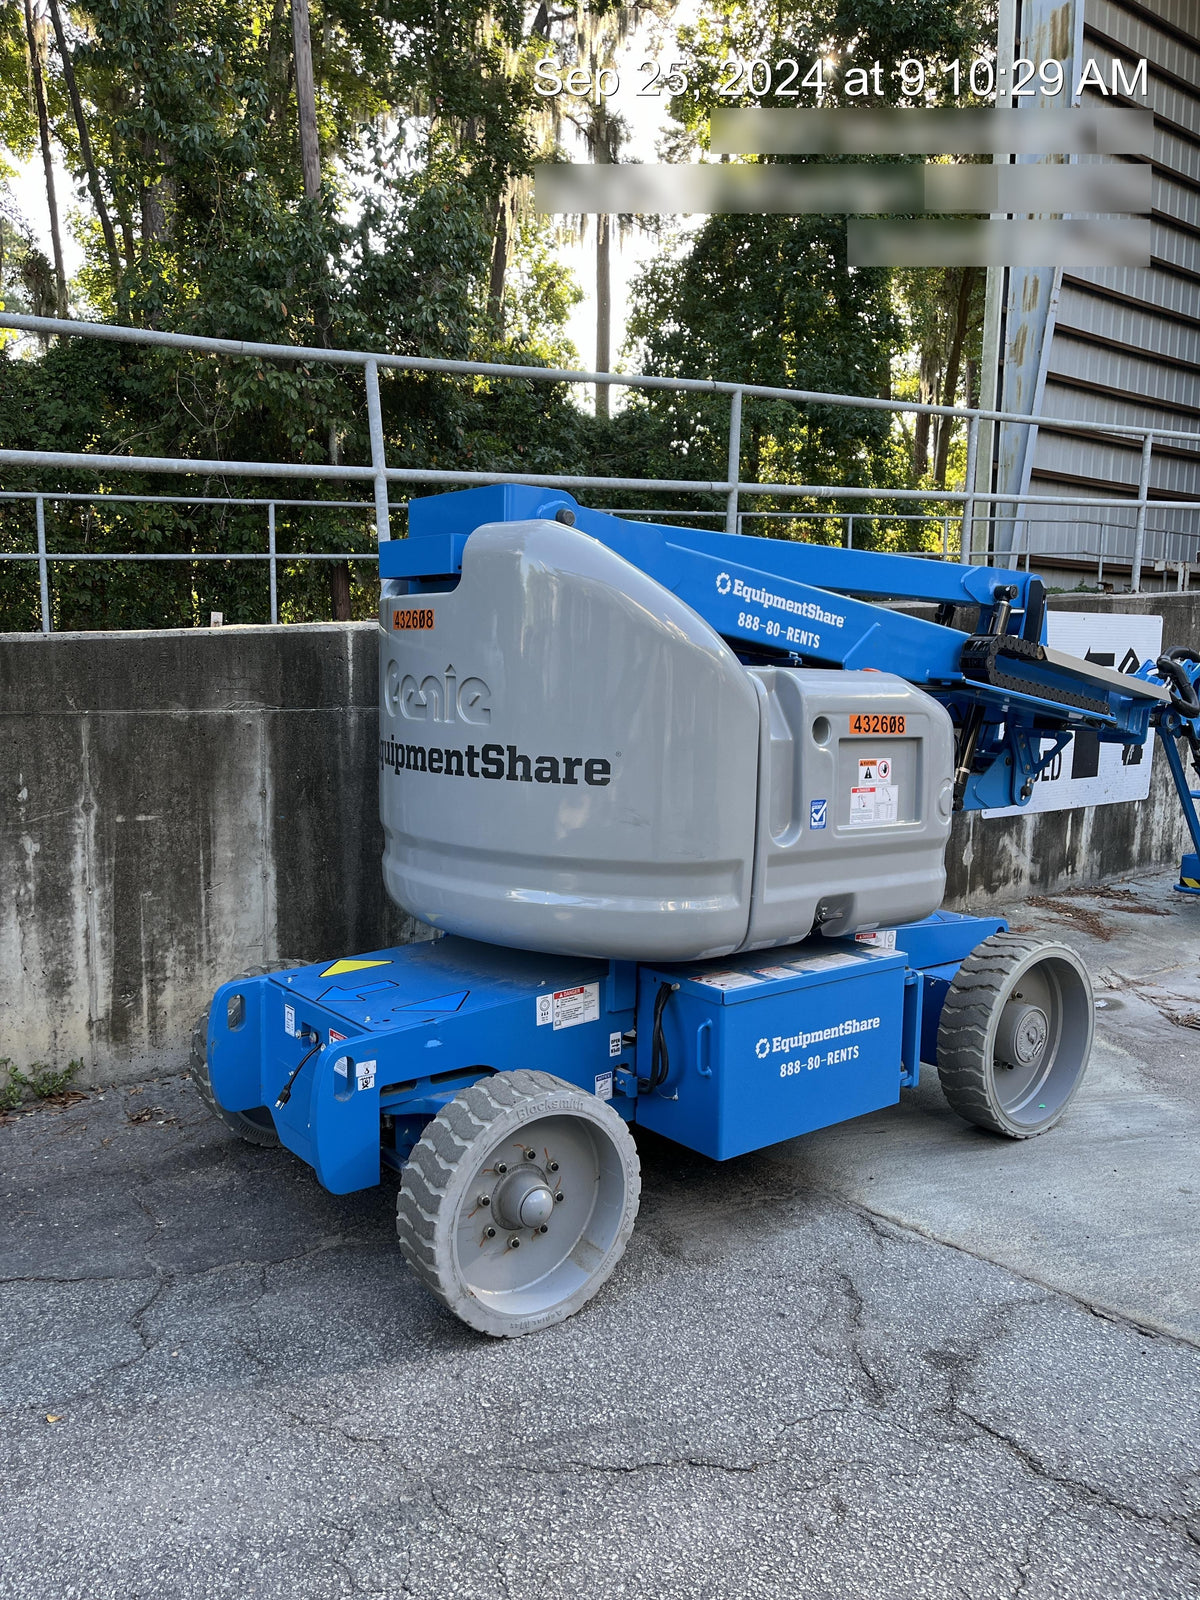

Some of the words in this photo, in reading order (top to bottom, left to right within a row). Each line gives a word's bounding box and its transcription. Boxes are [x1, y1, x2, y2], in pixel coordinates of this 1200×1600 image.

[394, 610, 434, 630] 432608
[732, 578, 845, 628] EquipmentShare
[737, 611, 821, 649] 888-80-RENTS
[384, 658, 492, 726] Genie
[853, 715, 905, 734] 432608
[379, 734, 612, 787] quipmentShare
[771, 1016, 880, 1054] EquipmentShare
[779, 1045, 860, 1078] 888-80-RENTS
